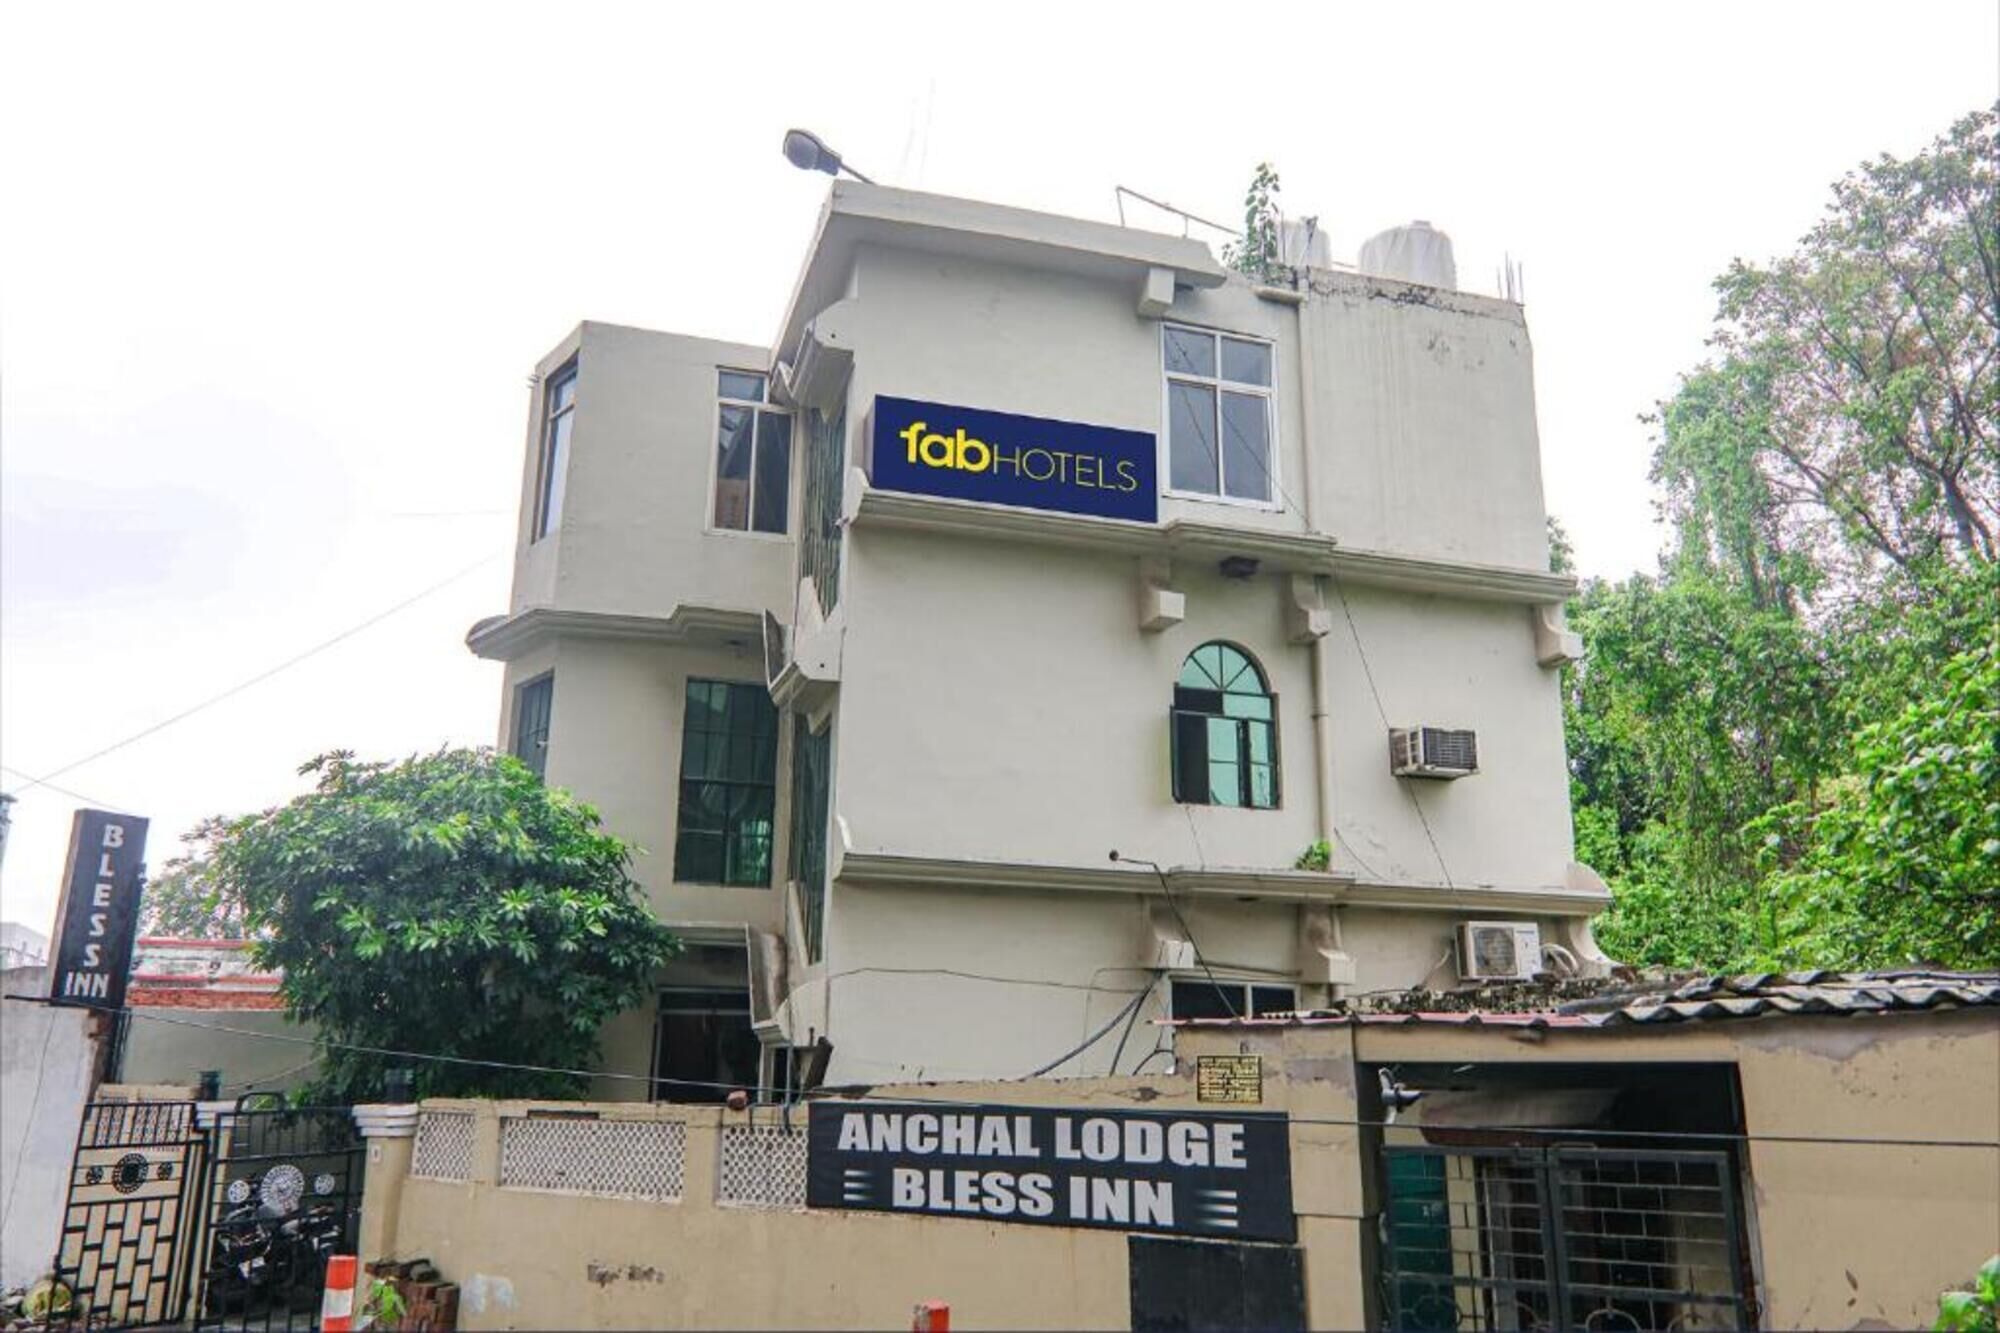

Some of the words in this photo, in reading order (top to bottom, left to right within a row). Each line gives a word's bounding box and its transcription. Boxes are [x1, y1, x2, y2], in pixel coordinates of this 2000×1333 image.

[83, 824, 125, 968] BLESS
[64, 972, 110, 998] INN
[837, 1113, 1040, 1158] ANCHAL
[1055, 1117, 1248, 1169] LODGE
[892, 1168, 1054, 1217] BLESS
[1069, 1175, 1175, 1227] INN
